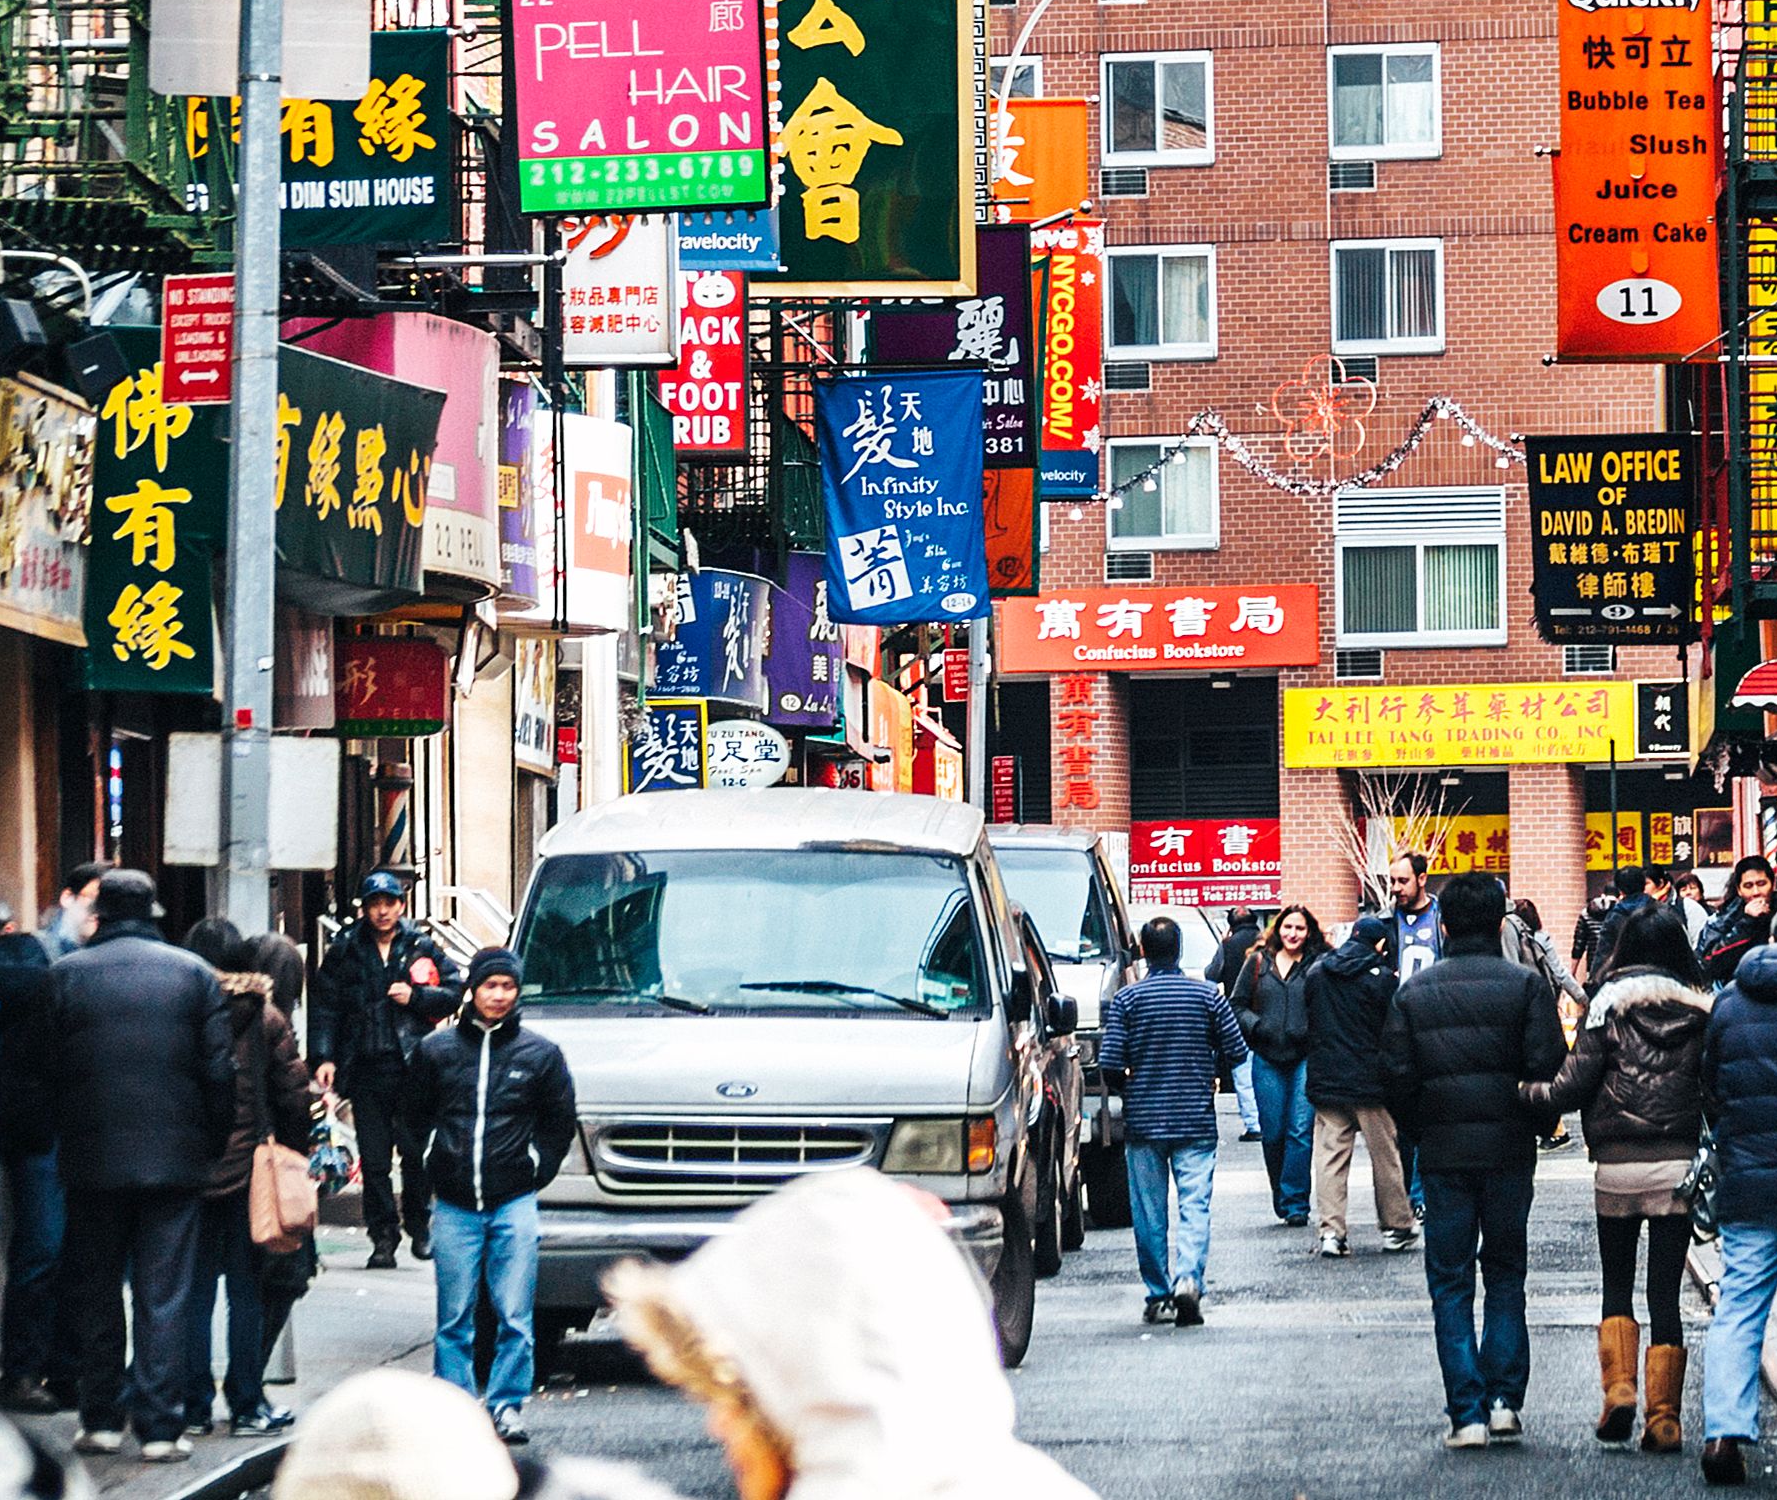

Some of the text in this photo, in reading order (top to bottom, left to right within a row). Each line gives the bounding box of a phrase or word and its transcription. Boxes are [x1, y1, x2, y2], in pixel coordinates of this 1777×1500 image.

[535, 20, 664, 81] PELL
[1583, 35, 1693, 69] 快可立
[629, 65, 751, 106] HAIR
[1569, 90, 1705, 110] Bubble Tea
[532, 111, 751, 153] SALON
[1630, 134, 1707, 155] Slush
[530, 154, 753, 187] 212-233-6789
[291, 180, 325, 209] DIM
[329, 179, 370, 208] SUM
[374, 176, 434, 205] HOUSE
[1596, 179, 1677, 200] Juice
[678, 233, 762, 252] ravelocity
[1569, 222, 1707, 244] Cream Cake
[561, 286, 659, 306] 妝品專門店
[1620, 287, 1658, 316] 11
[681, 316, 741, 345] ACK
[690, 350, 712, 379] &
[661, 382, 741, 411] FOOT
[673, 415, 731, 445] RUB
[986, 438, 1023, 453] 381
[1540, 449, 1681, 484] LAW OFFICE
[861, 476, 939, 496] Infinity
[1597, 487, 1627, 506] OF
[884, 499, 933, 519] Style
[1541, 508, 1685, 536] DAVID A. BREDIN
[1034, 595, 1284, 640] 萬有書局
[1074, 643, 1245, 661] Confucius Bookstore
[784, 697, 797, 708] 12
[722, 730, 734, 738] ZU
[739, 730, 765, 738] TANG
[1057, 672, 1100, 809] 萬有書局
[1308, 731, 1334, 745] TAI
[1345, 731, 1373, 745] LEE
[1389, 730, 1433, 744] TANG
[1446, 727, 1524, 743] TRADING
[722, 777, 747, 788] 12-C
[1131, 860, 1202, 874] onfucius
[1472, 855, 1509, 870] LEE
